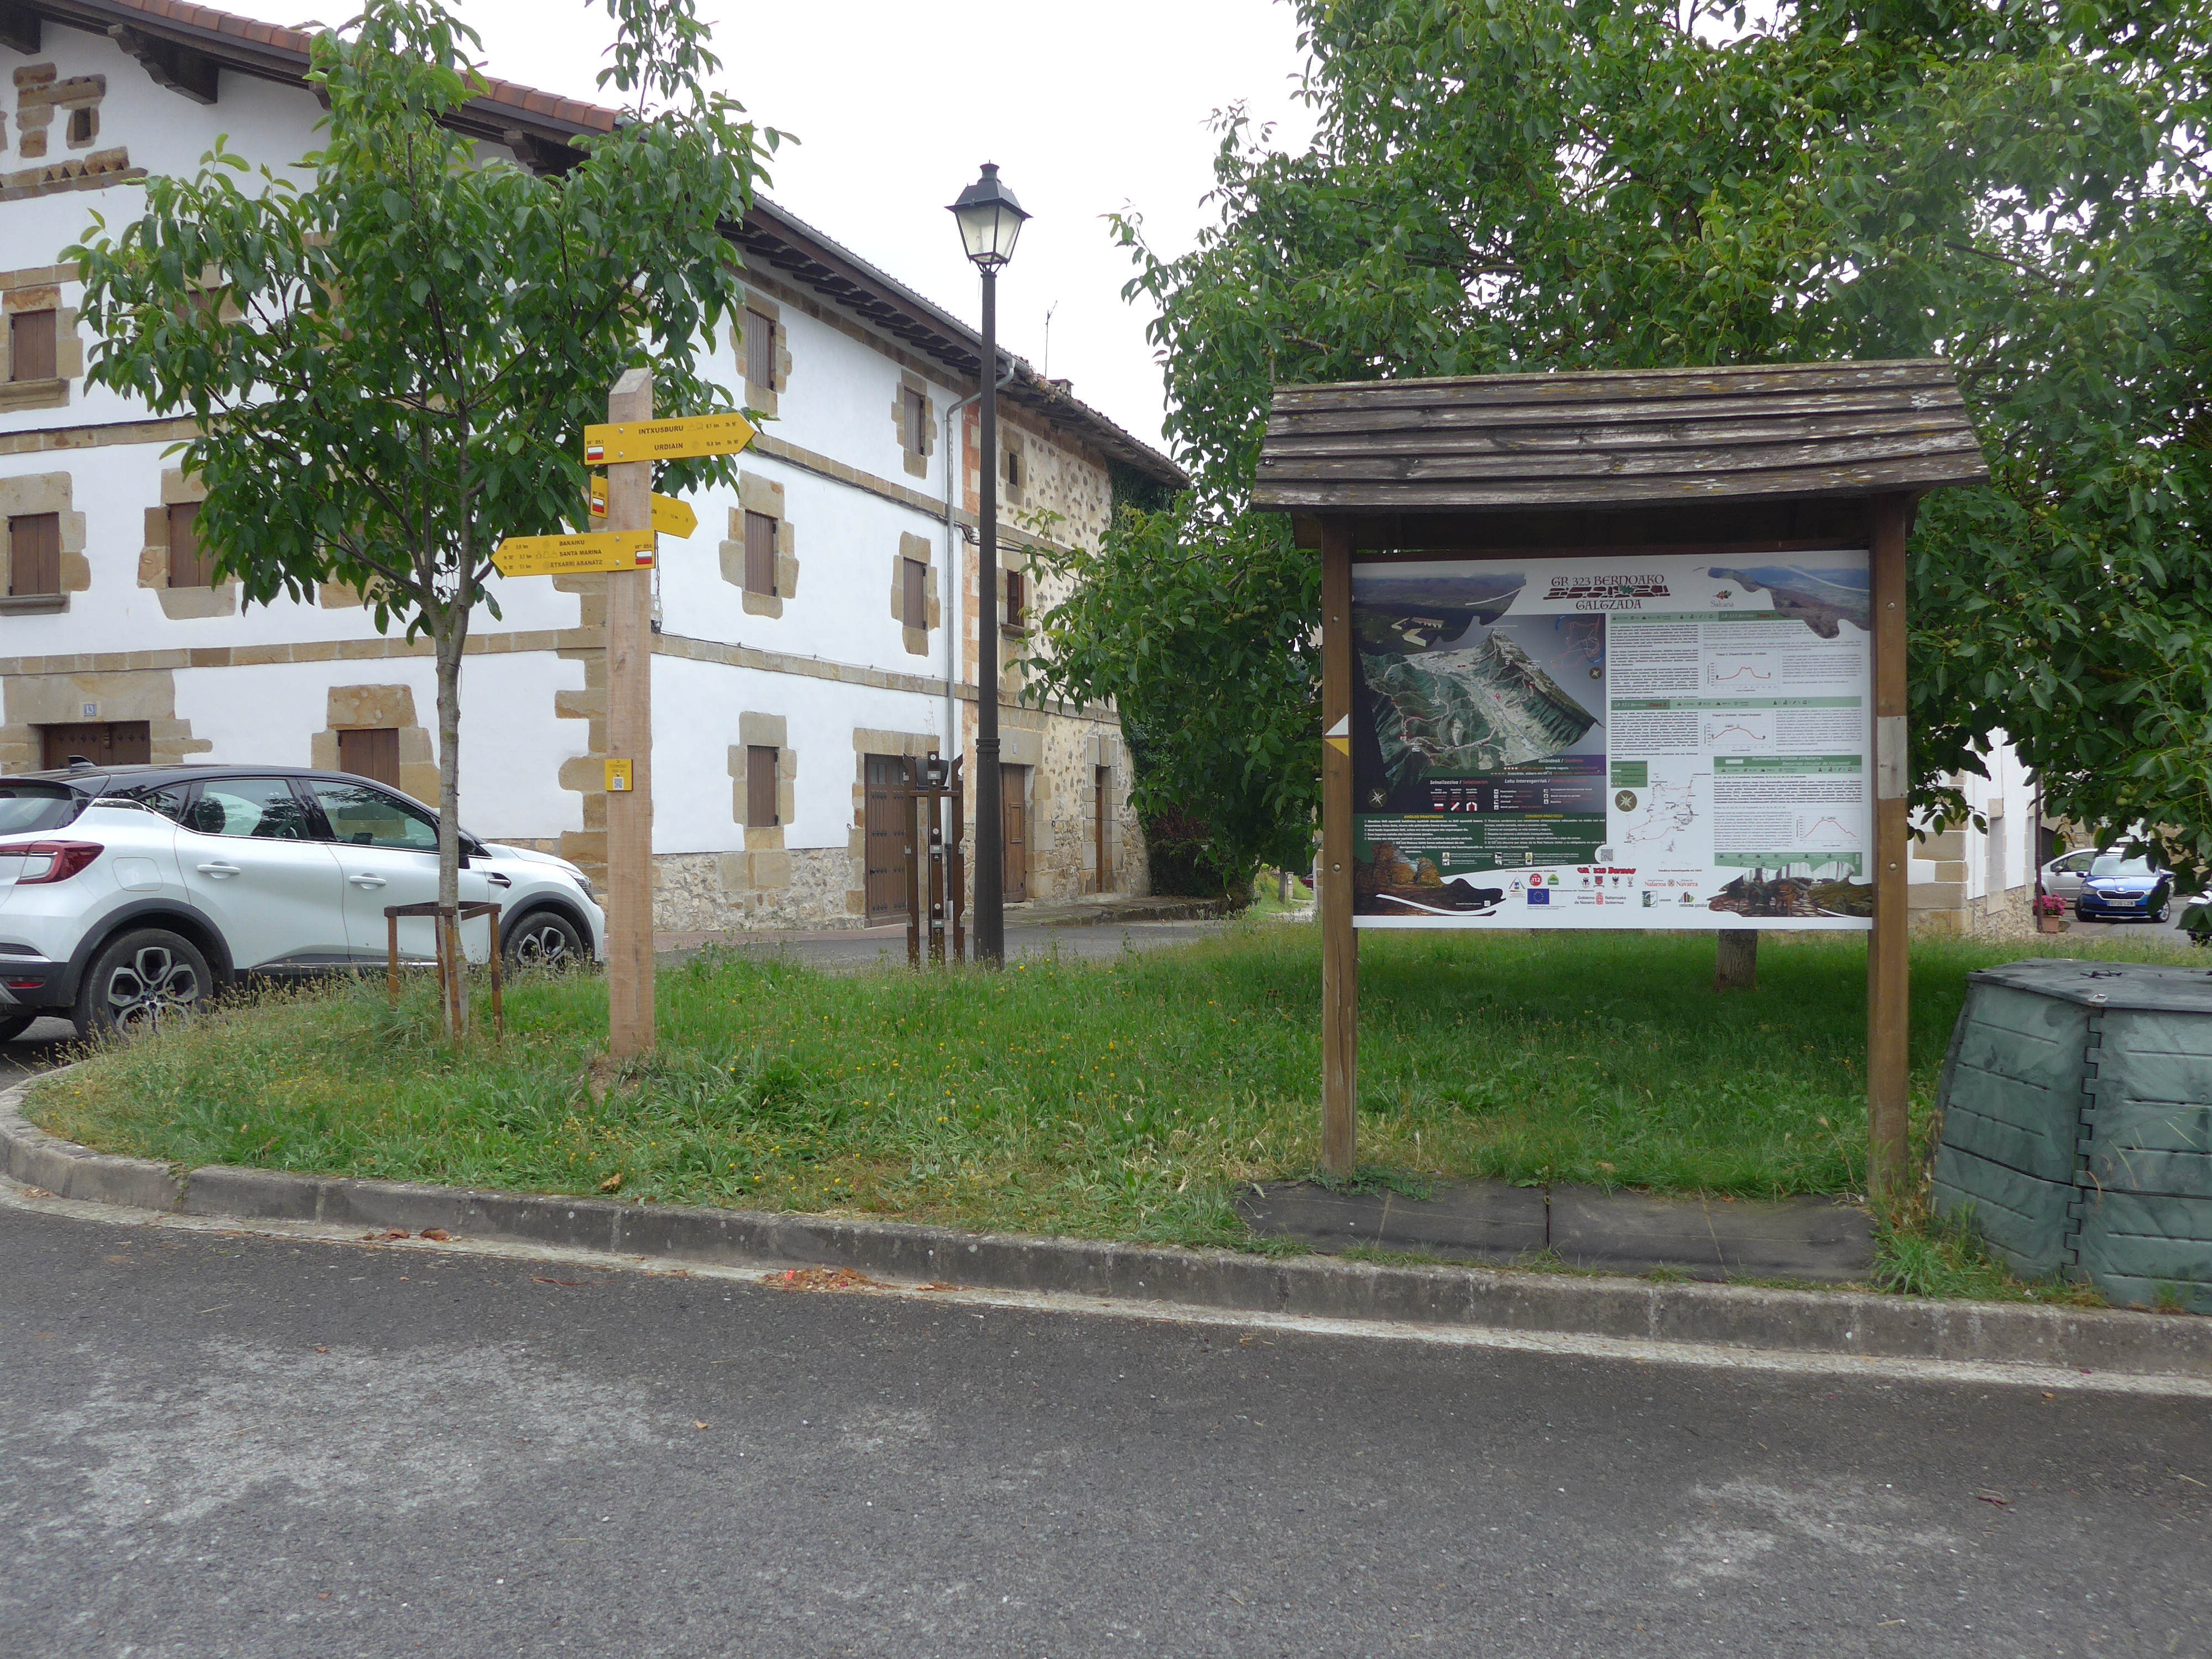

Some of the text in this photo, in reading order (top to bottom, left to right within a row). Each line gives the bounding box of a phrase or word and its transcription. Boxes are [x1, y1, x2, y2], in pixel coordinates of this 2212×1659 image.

[638, 425, 684, 435] INTXUSBURU
[654, 442, 684, 451] URDIAIN
[1551, 575, 1665, 587] GR 323 BERNOAKO
[1575, 599, 1642, 611] GALTZADA
[86, 705, 93, 714] 13
